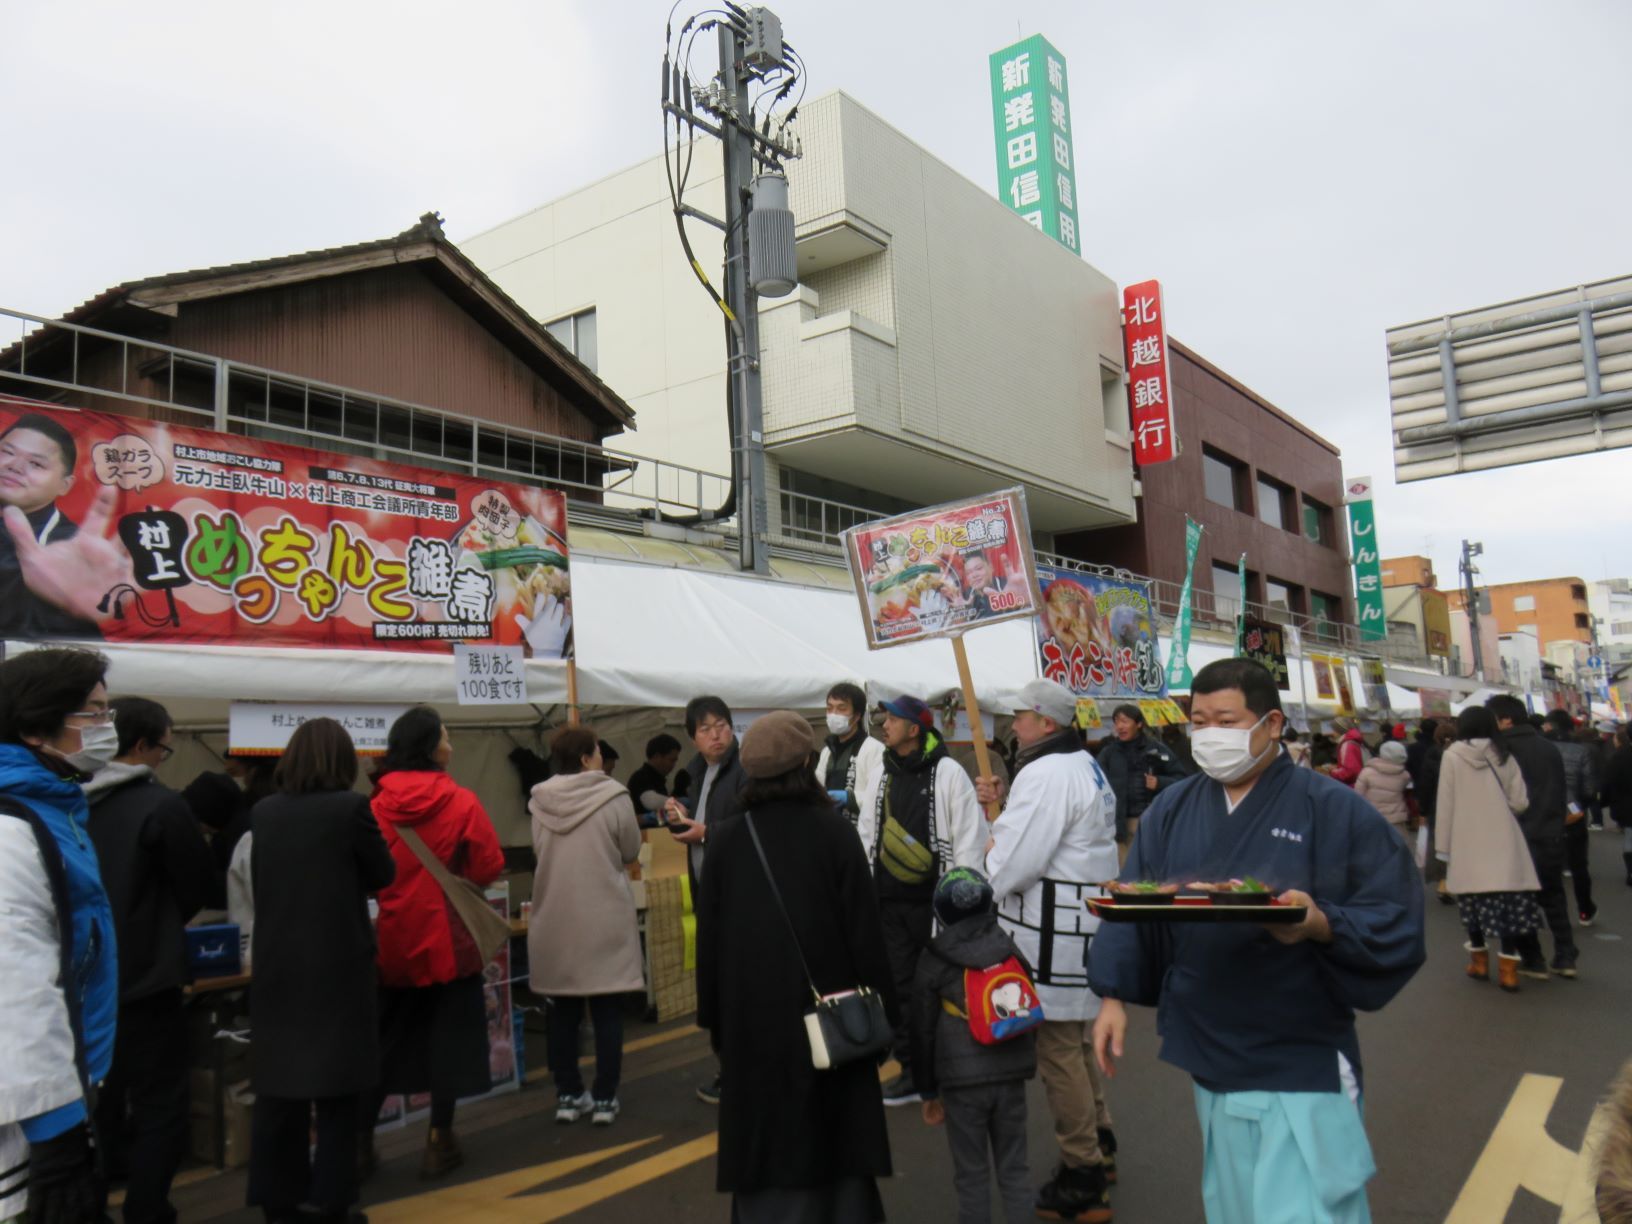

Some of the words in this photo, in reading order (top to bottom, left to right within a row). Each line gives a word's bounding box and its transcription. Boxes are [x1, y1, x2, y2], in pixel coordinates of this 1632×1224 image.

[1047, 55, 1077, 250] 新発田信用
[1128, 296, 1167, 449] 北越銀行
[104, 448, 151, 463] 鶏ガラ
[107, 465, 153, 479] スープ
[138, 520, 181, 581] 村上
[1353, 519, 1381, 621] しんきん
[468, 652, 514, 675] 残りあと
[461, 677, 524, 700] 100食です
